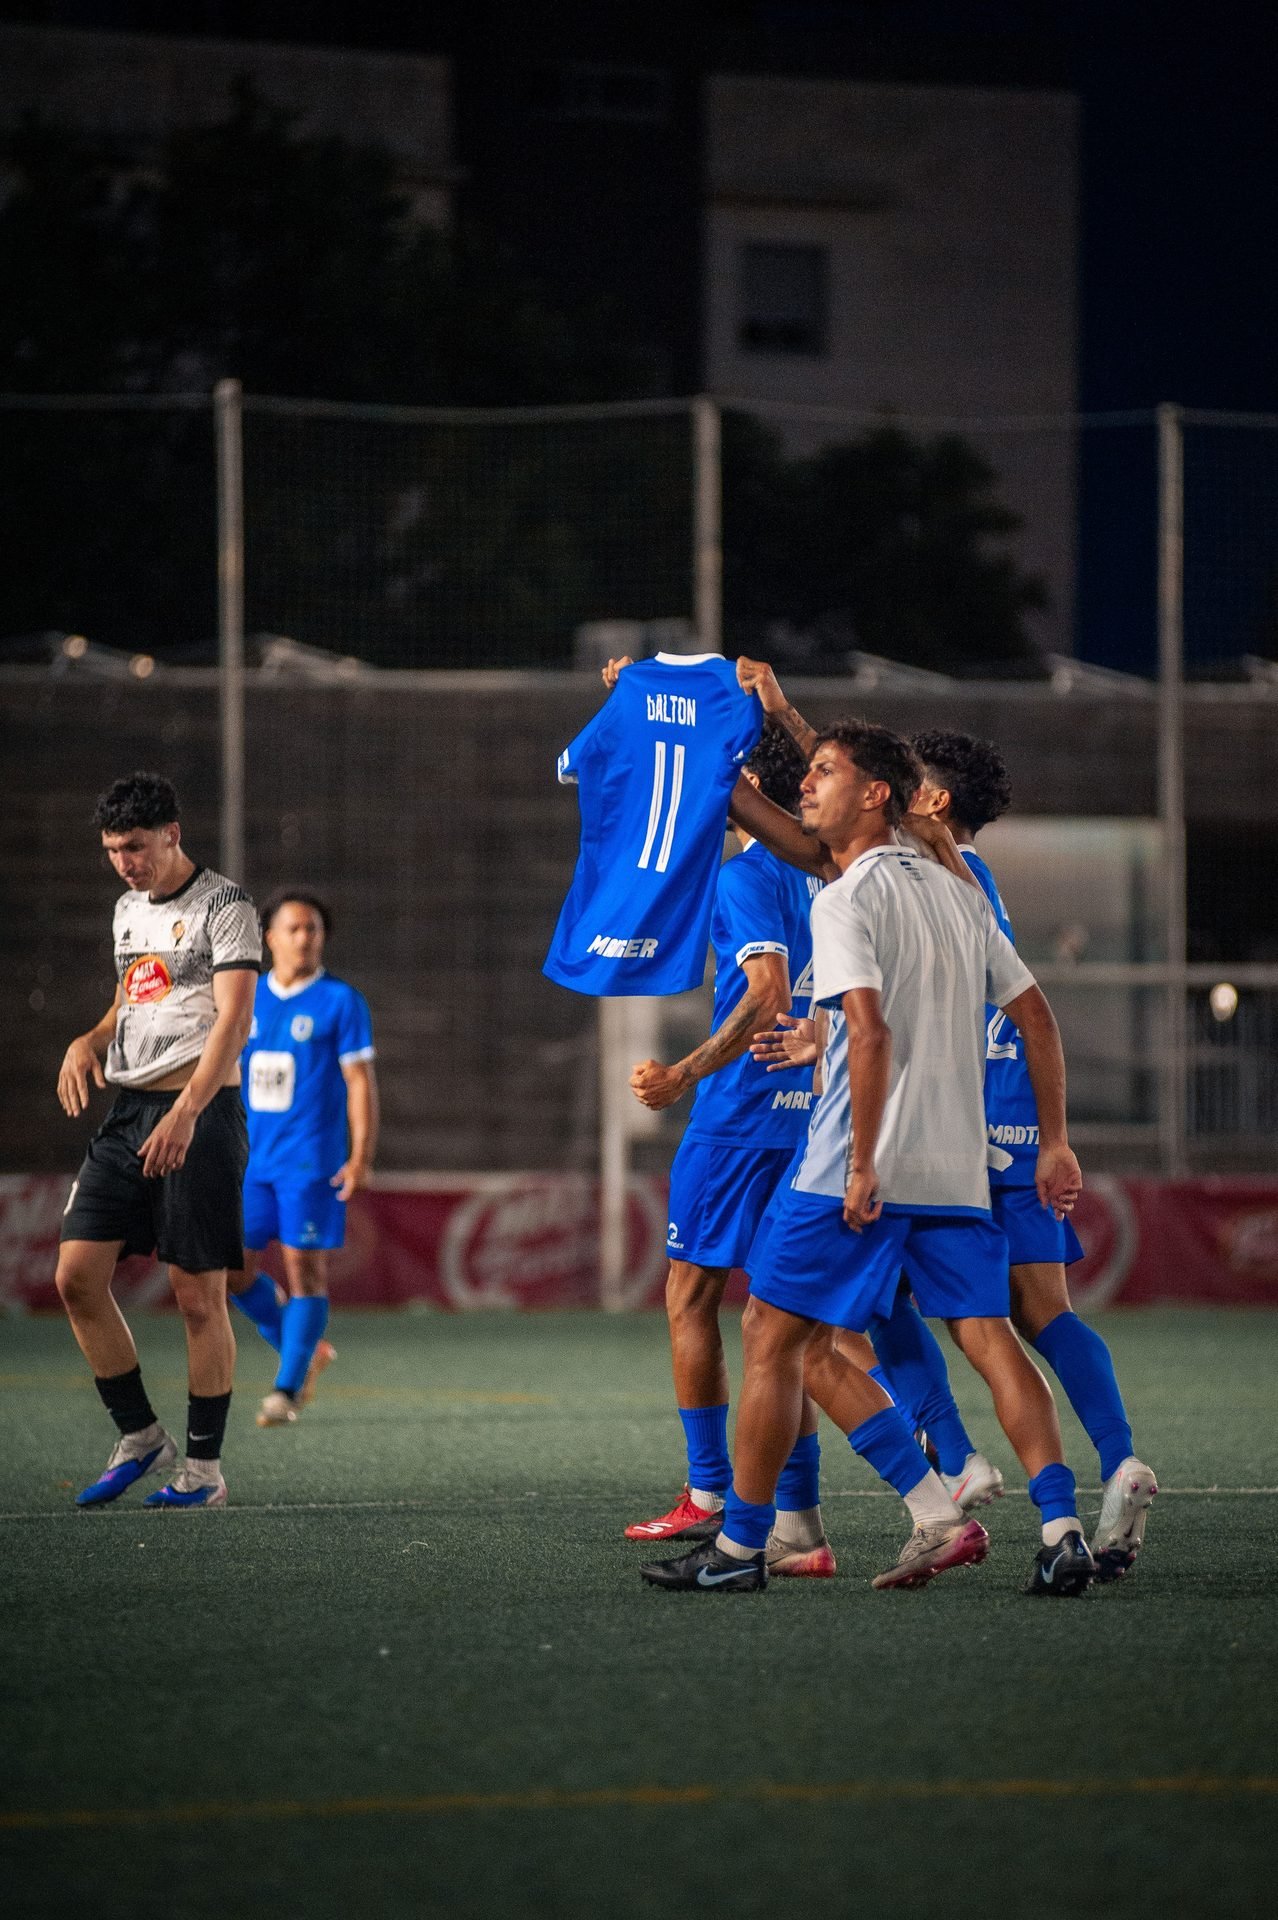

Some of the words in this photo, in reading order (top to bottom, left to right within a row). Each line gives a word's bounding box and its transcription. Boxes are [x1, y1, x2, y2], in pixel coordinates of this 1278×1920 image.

[646, 693, 696, 727] DALTON
[637, 741, 685, 873] 11
[131, 959, 156, 984] MAX
